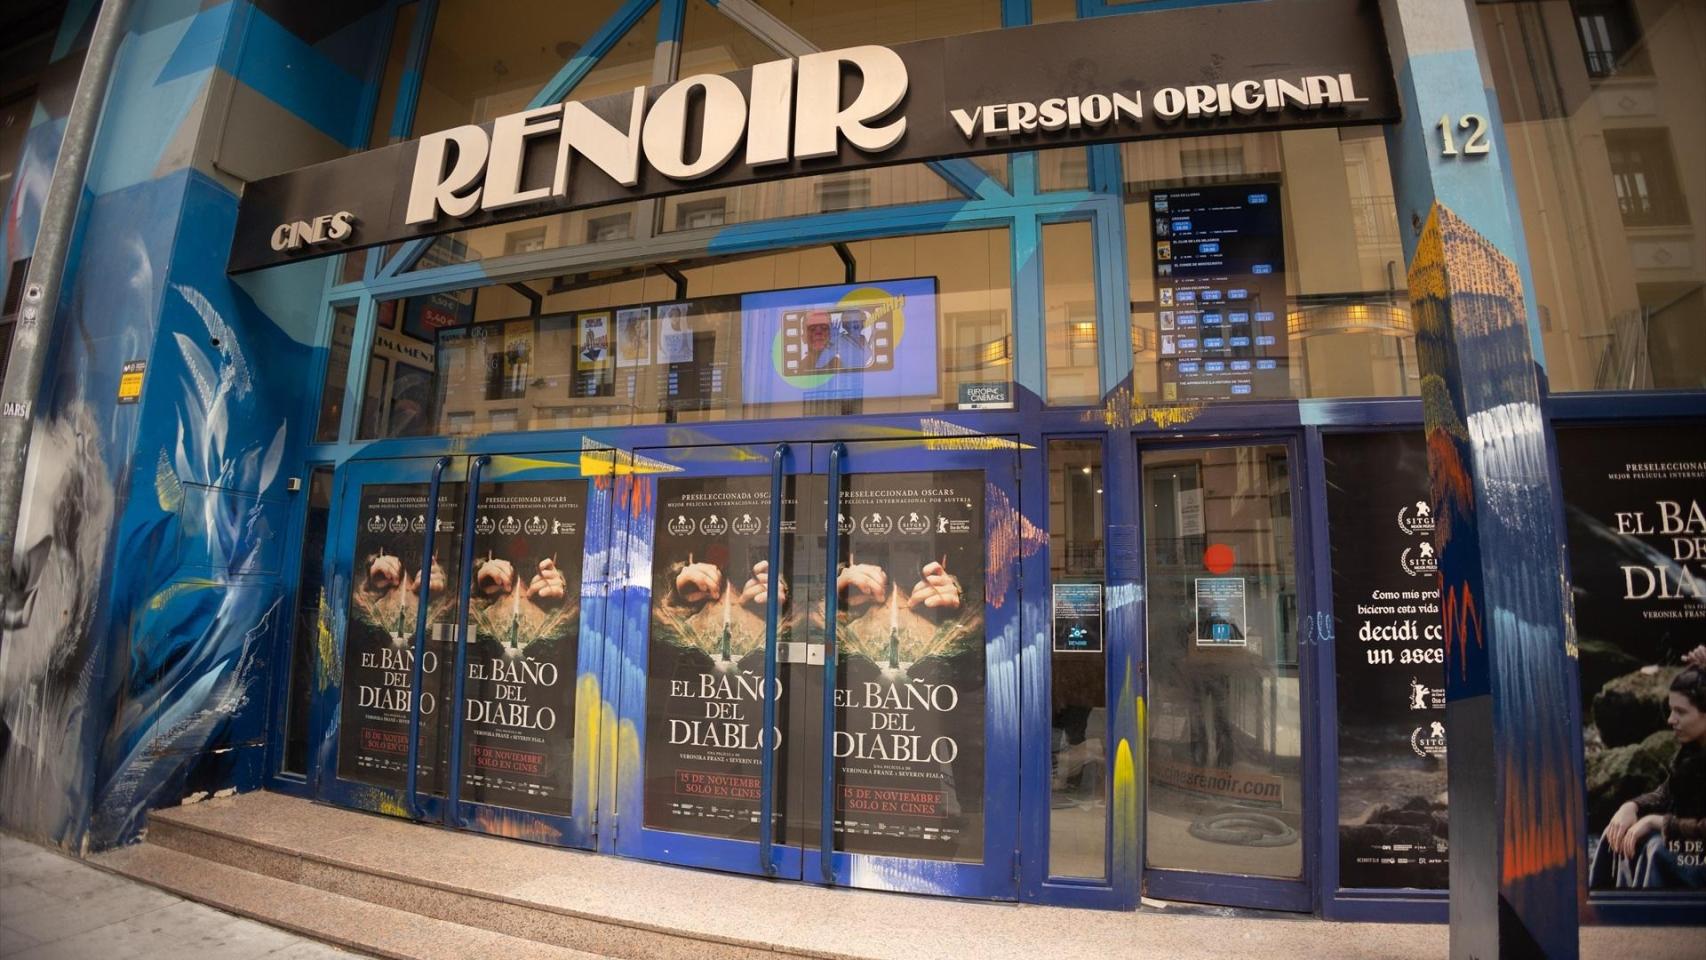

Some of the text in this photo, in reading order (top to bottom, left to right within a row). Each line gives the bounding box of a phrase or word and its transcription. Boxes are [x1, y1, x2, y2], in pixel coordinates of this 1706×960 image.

[950, 73, 1369, 140] VERSION ORIGINAL
[405, 45, 909, 226] RENOIR
[1436, 113, 1490, 155] 12
[270, 210, 356, 252] CINES
[682, 492, 751, 501] PRESELECCIONADA
[840, 488, 955, 498] PRESELECCIONADA OSCARS
[1406, 517, 1435, 525] SITG
[1614, 499, 1706, 535] EL BA
[1672, 537, 1706, 561] DE
[1409, 558, 1438, 566] SITG
[1620, 563, 1706, 600] DIA
[1372, 589, 1400, 600] Como
[1402, 589, 1420, 600] mis
[1397, 604, 1417, 614] esta
[1418, 603, 1439, 614] vida
[1642, 609, 1706, 619] VERONIKA FRAN
[361, 652, 379, 668] EL
[1367, 647, 1444, 665] un ases
[384, 671, 411, 689] DEL
[468, 656, 558, 688] EL BAÑO
[495, 684, 528, 702] DEL
[670, 670, 783, 702] EL BAÑO
[833, 677, 959, 712] EL BAÑO
[465, 699, 557, 731] DIABLO
[705, 701, 745, 721] DEL
[870, 712, 916, 732] DEL
[668, 719, 783, 751] DIABLO
[482, 747, 493, 757] DE
[495, 749, 543, 764] NOVIEMBRE
[832, 731, 959, 764] DIABLO
[478, 757, 538, 774] SOLO EN CINES
[680, 753, 707, 761] VERONIKA
[707, 755, 725, 763] FRANZ
[729, 756, 753, 764] SEVERIN
[680, 773, 761, 788] 15 DE NOVIEMBR
[842, 767, 873, 775] VERONIKA
[873, 768, 894, 776] FRANZ
[899, 770, 925, 778] SEVERIN
[926, 771, 944, 779] FIALA
[686, 783, 761, 799] SOLO EN CINES
[844, 788, 942, 804] 15 DE NOVIEMBRE
[849, 799, 936, 815] SOLO EN CINES
[1669, 840, 1704, 852] 15 DE
[1677, 854, 1706, 866] SOL
